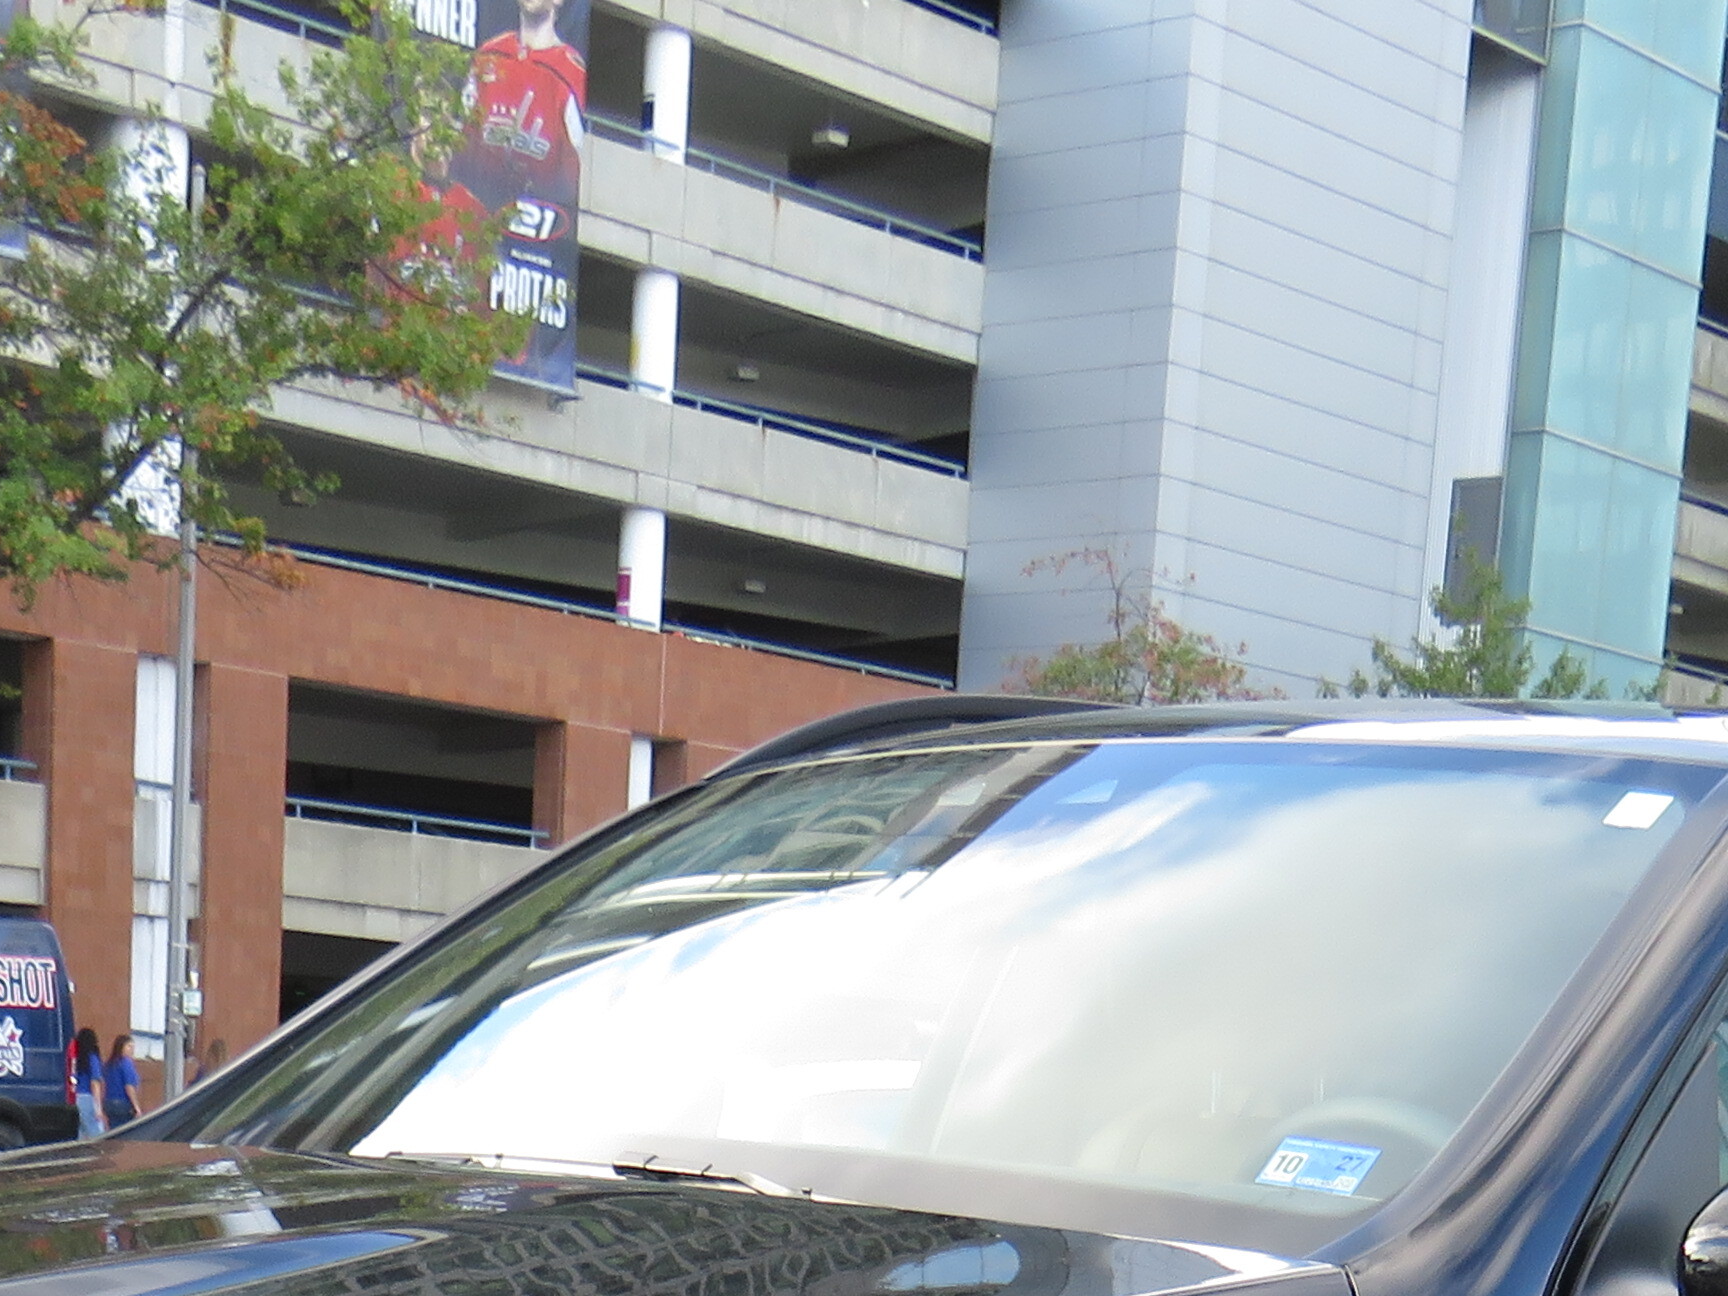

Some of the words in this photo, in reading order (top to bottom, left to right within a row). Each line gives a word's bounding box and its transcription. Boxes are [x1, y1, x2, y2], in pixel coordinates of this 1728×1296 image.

[508, 200, 556, 240] 21
[489, 262, 568, 329] PROTAS
[1273, 1153, 1304, 1175] 10
[1334, 1155, 1368, 1173] 27
